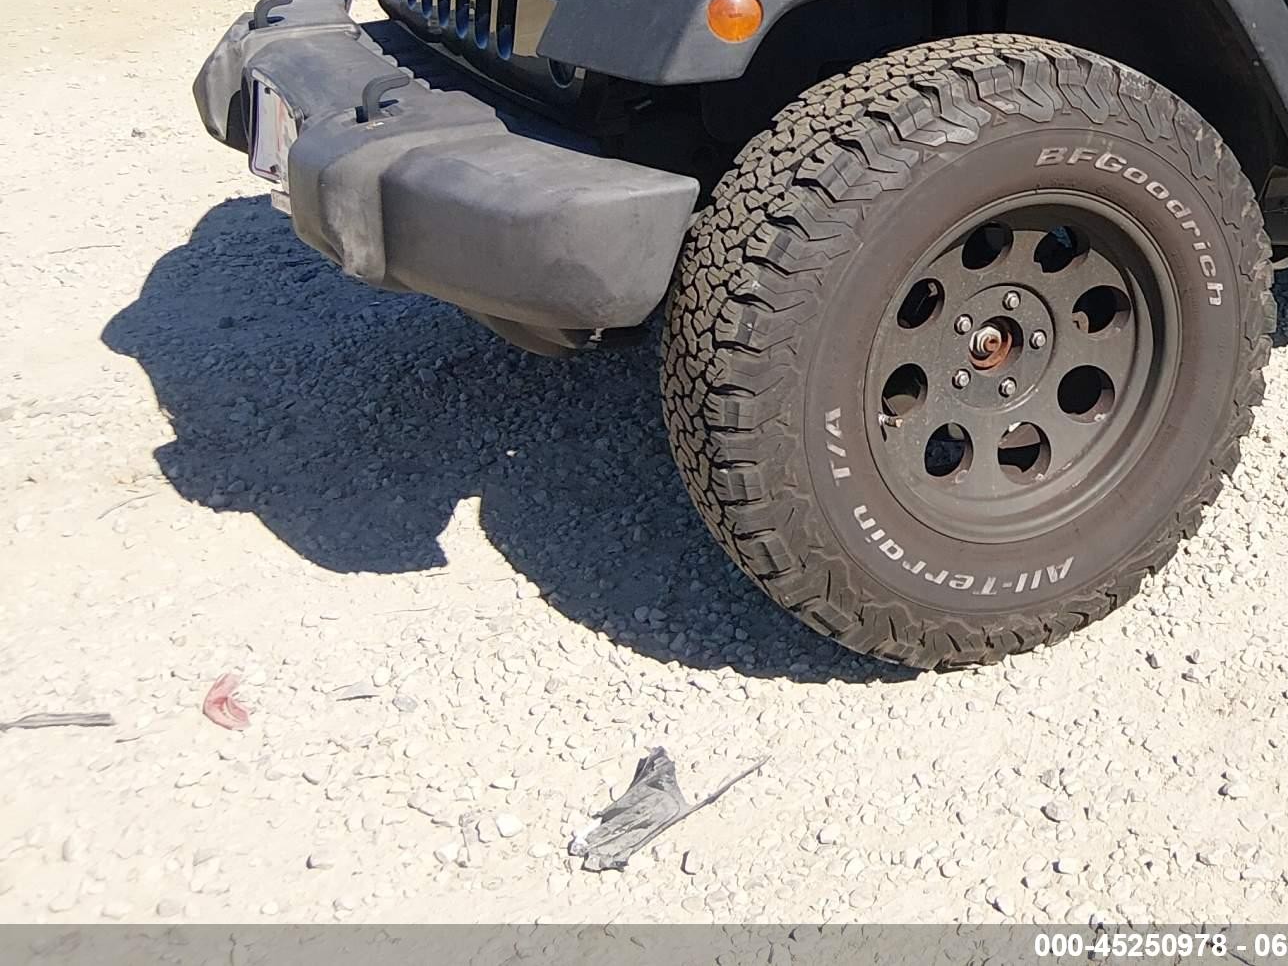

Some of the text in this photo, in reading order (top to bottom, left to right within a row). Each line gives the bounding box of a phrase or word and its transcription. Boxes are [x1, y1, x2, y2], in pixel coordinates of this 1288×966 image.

[1035, 147, 1223, 306] BFGoodrich
[825, 407, 1074, 595] All-Terrain T/A
